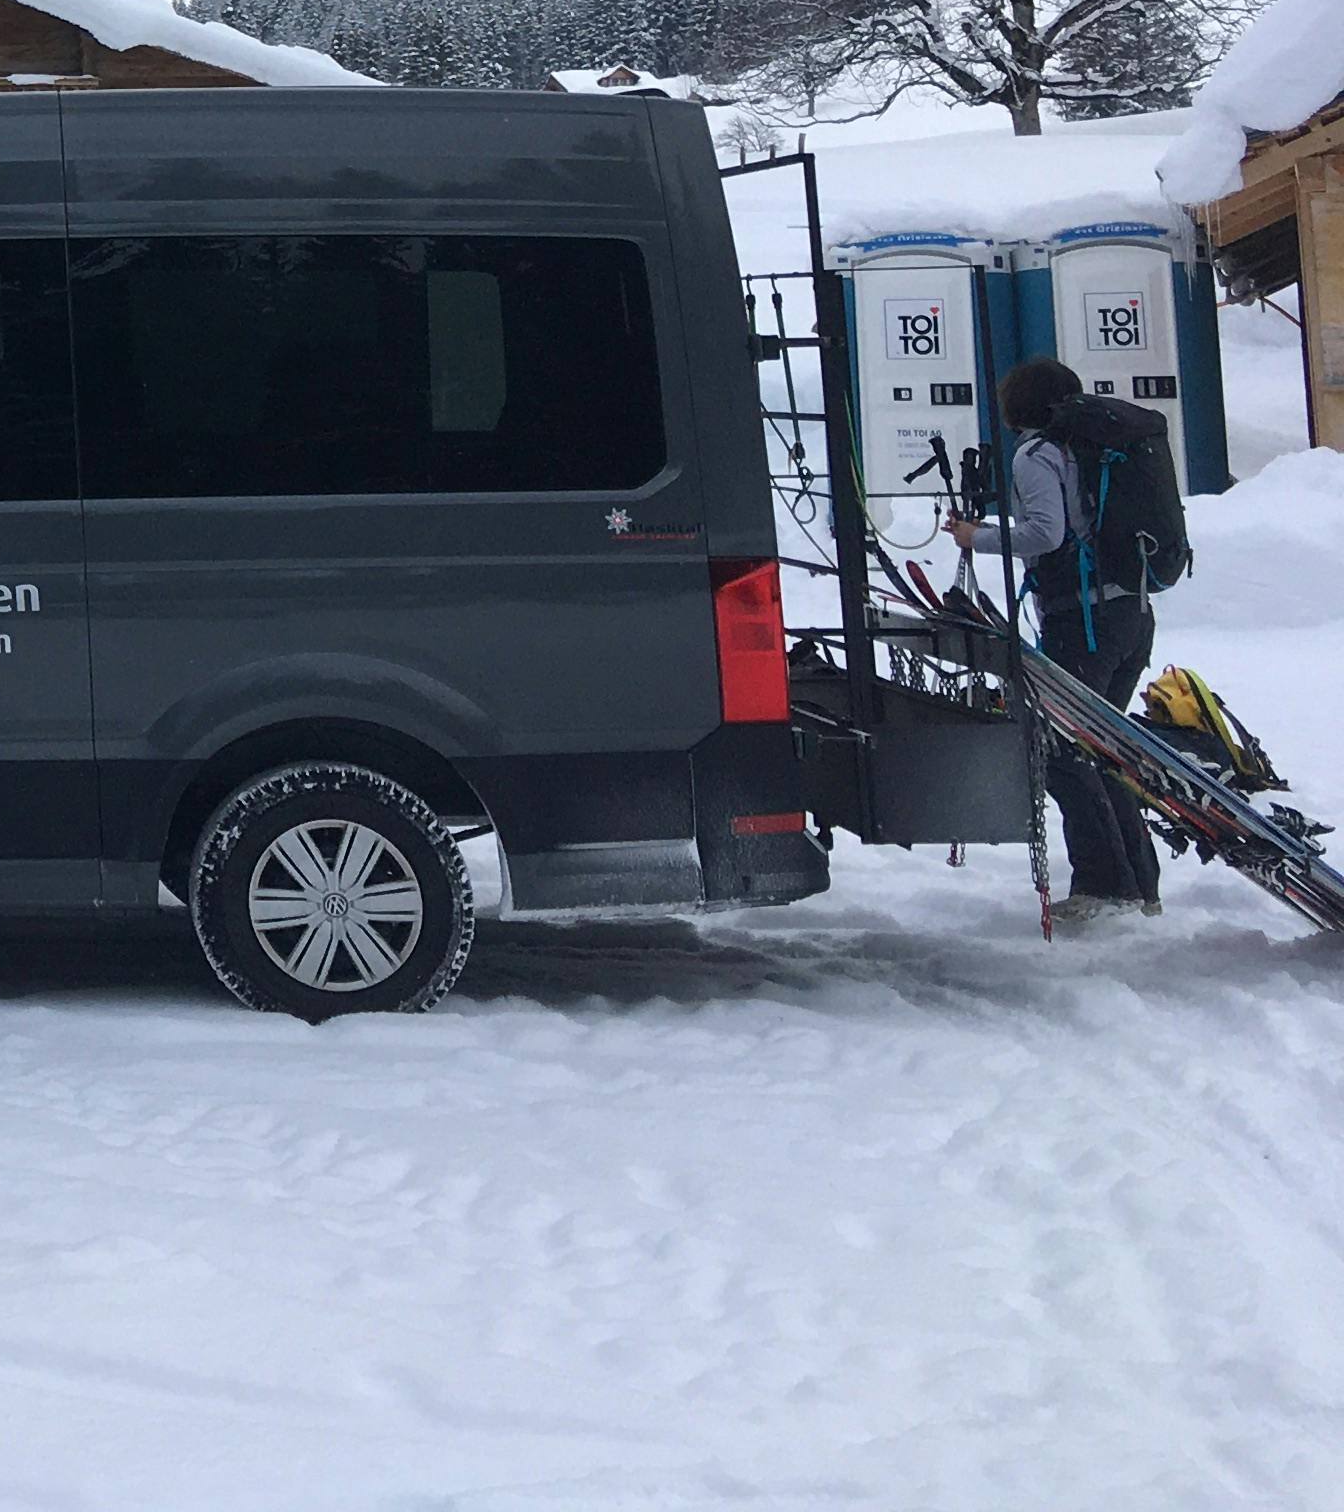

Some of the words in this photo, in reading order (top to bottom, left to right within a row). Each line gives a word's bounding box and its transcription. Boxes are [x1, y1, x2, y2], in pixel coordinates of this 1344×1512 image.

[899, 335, 940, 355] TOI
[1099, 327, 1140, 346] TOI
[897, 429, 911, 437] TOI
[914, 429, 928, 437] TOI
